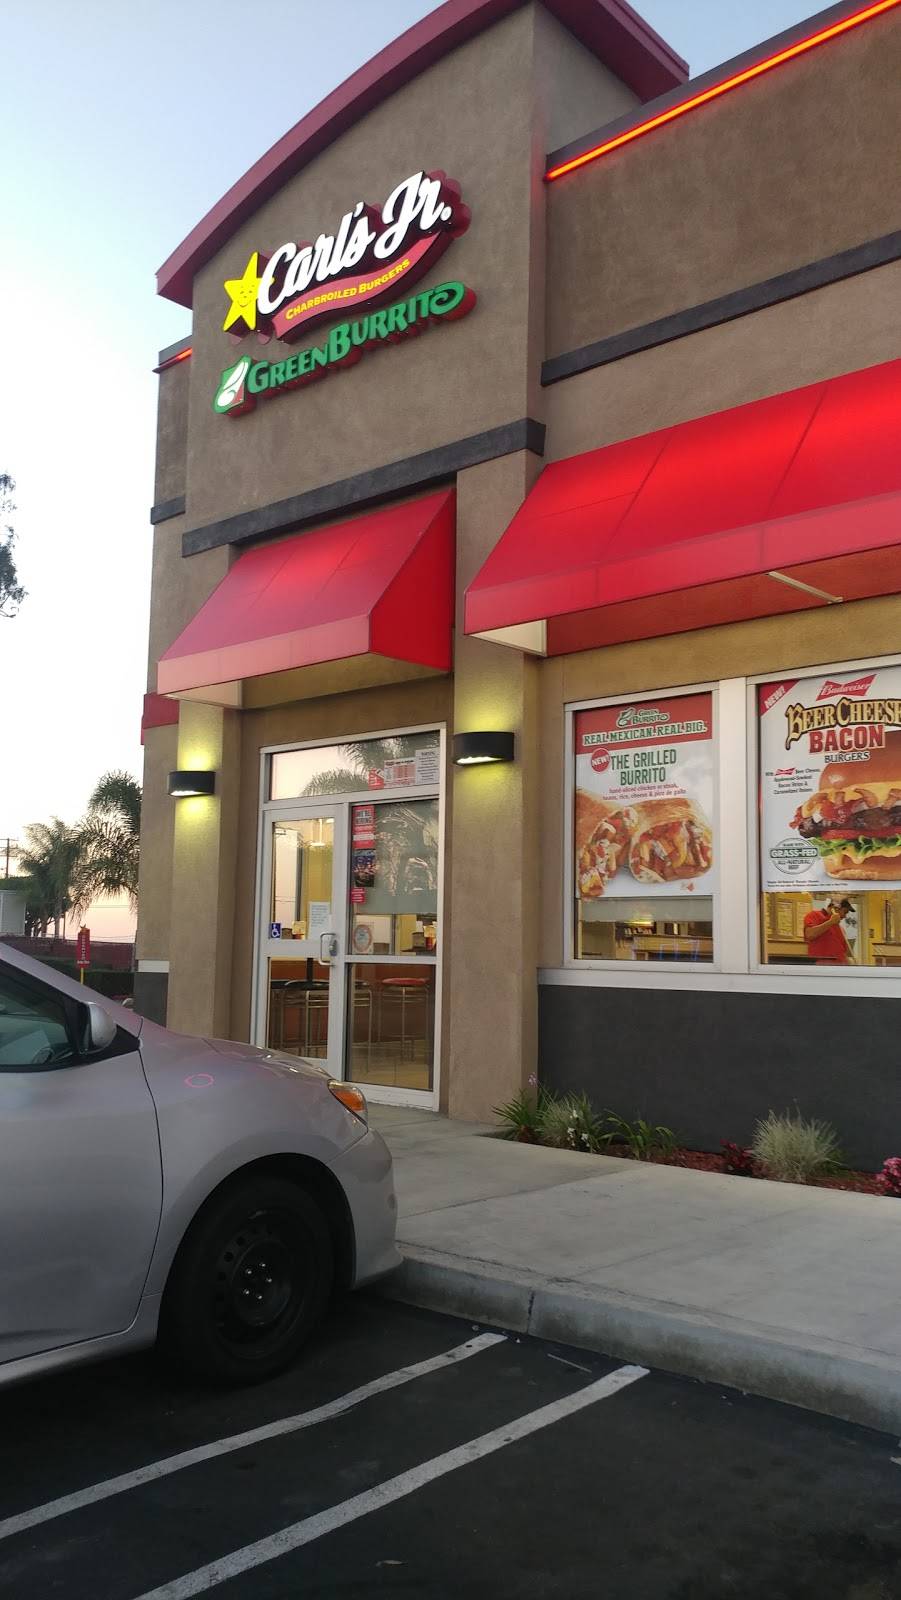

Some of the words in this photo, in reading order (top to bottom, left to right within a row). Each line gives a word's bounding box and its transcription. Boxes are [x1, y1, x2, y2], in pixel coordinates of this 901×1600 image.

[257, 201, 376, 315] Carl's
[373, 170, 452, 259] Jr.
[285, 287, 357, 320] CHARBROILED
[358, 259, 411, 295] BURGERS
[633, 714, 668, 724] BURRITO
[584, 733, 607, 745] REAL
[657, 723, 682, 736] REAL
[809, 724, 884, 753] BACON
[611, 754, 630, 770] THE
[633, 749, 676, 768] GRILLED
[824, 751, 870, 763] BURGERS
[620, 766, 666, 785] BURRITO
[771, 848, 817, 858] GRASS-FED
